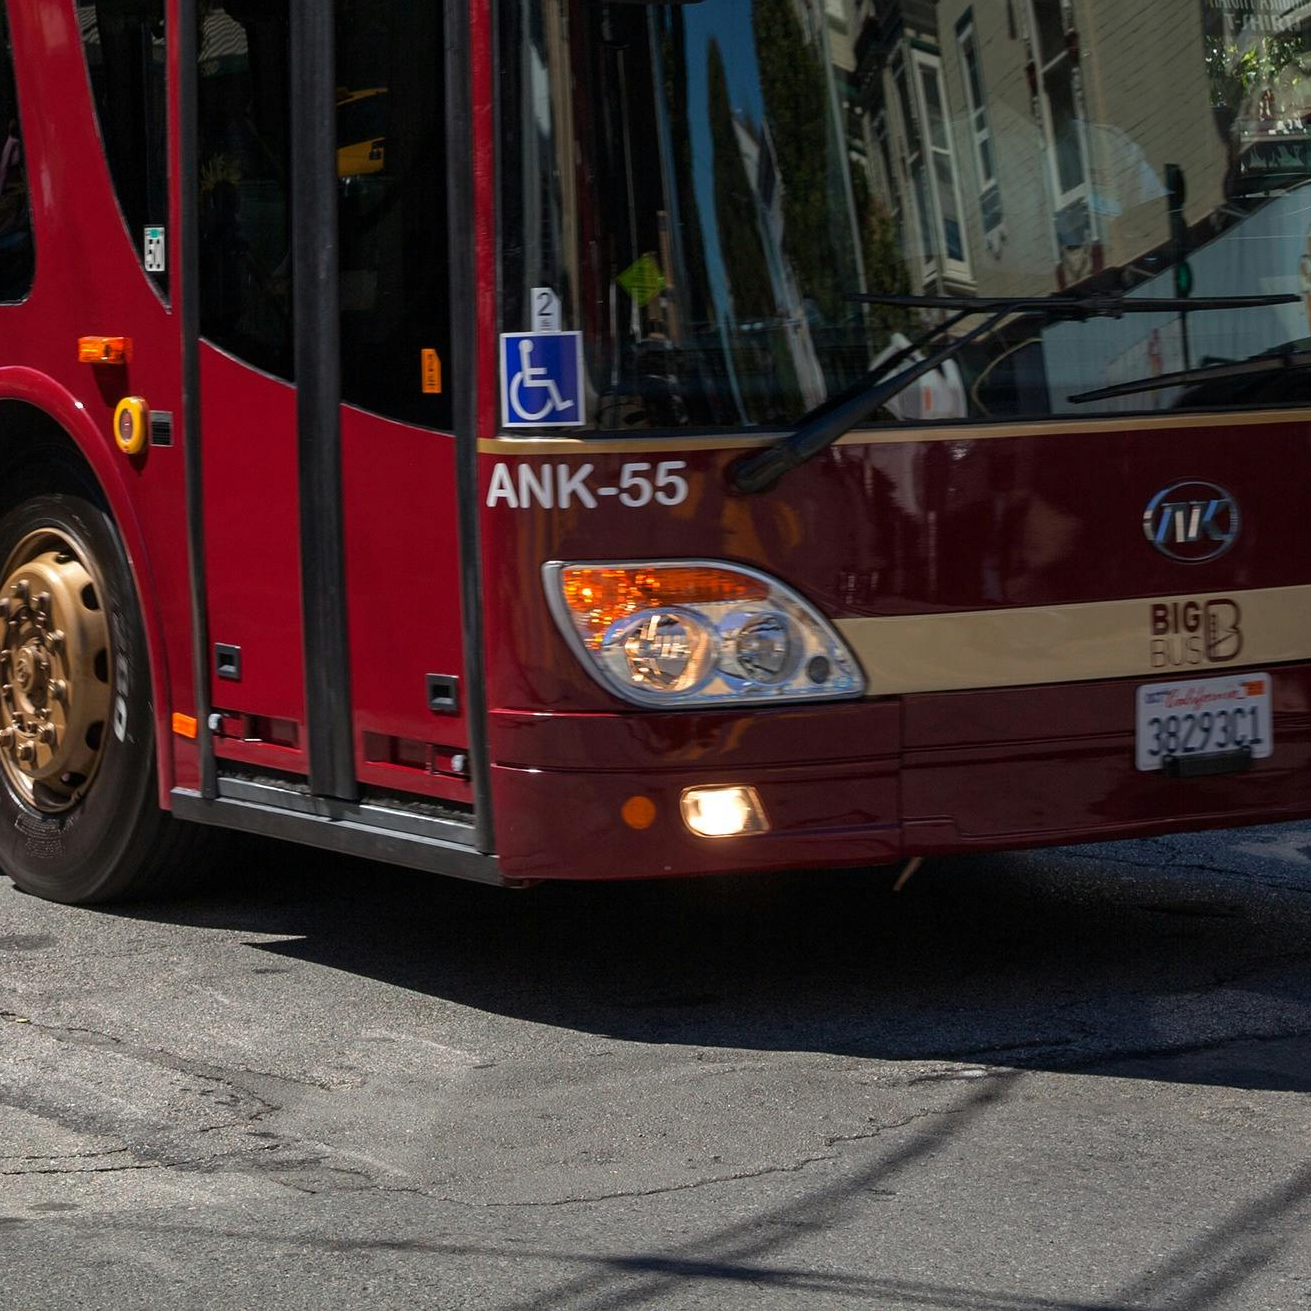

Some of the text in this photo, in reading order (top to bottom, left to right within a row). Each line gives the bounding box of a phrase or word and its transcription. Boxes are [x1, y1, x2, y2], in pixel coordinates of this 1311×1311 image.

[536, 291, 554, 316] 2
[486, 460, 689, 510] ANK-55
[1150, 601, 1200, 635] BIG
[1150, 636, 1202, 667] BUS
[1147, 705, 1264, 757] 38293C1
